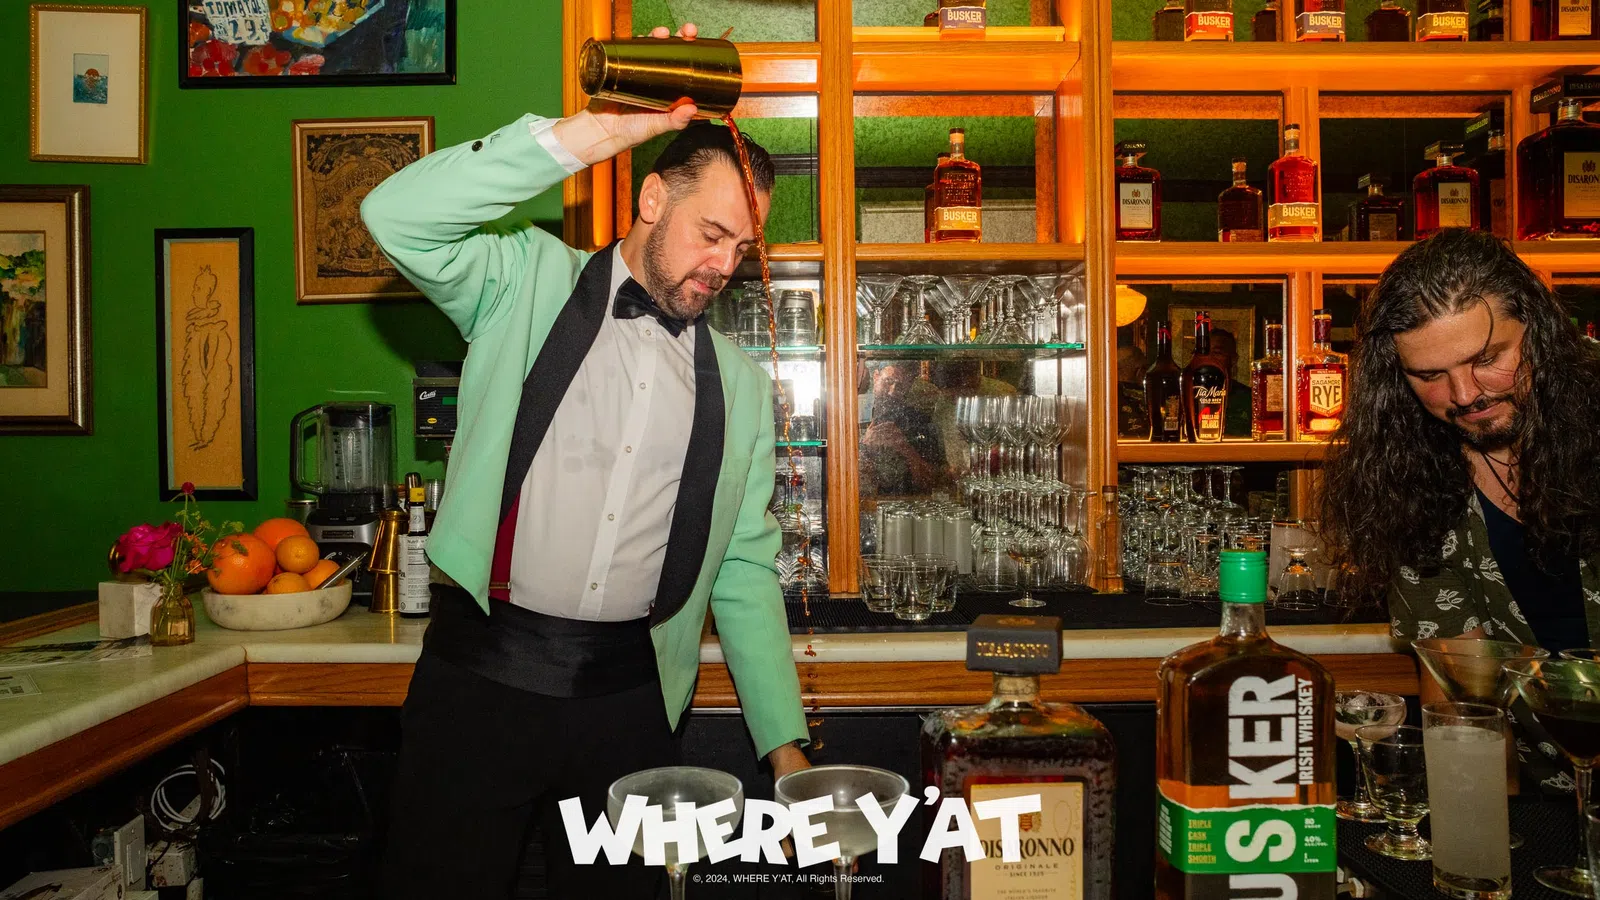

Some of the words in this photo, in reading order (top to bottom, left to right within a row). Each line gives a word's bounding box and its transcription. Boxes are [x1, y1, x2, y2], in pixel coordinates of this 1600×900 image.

[947, 10, 982, 21] BUSKER
[1198, 15, 1231, 27] BUSKER
[1309, 15, 1342, 27] BUSKER
[1432, 16, 1467, 27] BUSKER
[1122, 198, 1151, 206] DISARONNO
[943, 210, 977, 222] BUSKER
[1282, 206, 1316, 217] BUSKER
[1193, 386, 1208, 398] Tia
[1312, 385, 1342, 408] RYE
[1298, 678, 1314, 745] WHISKEY
[1298, 746, 1314, 785] IRISH
[1188, 831, 1207, 841] CASK
[1188, 855, 1217, 864] SMOOTH
[994, 863, 1060, 871] ORIGINALE
